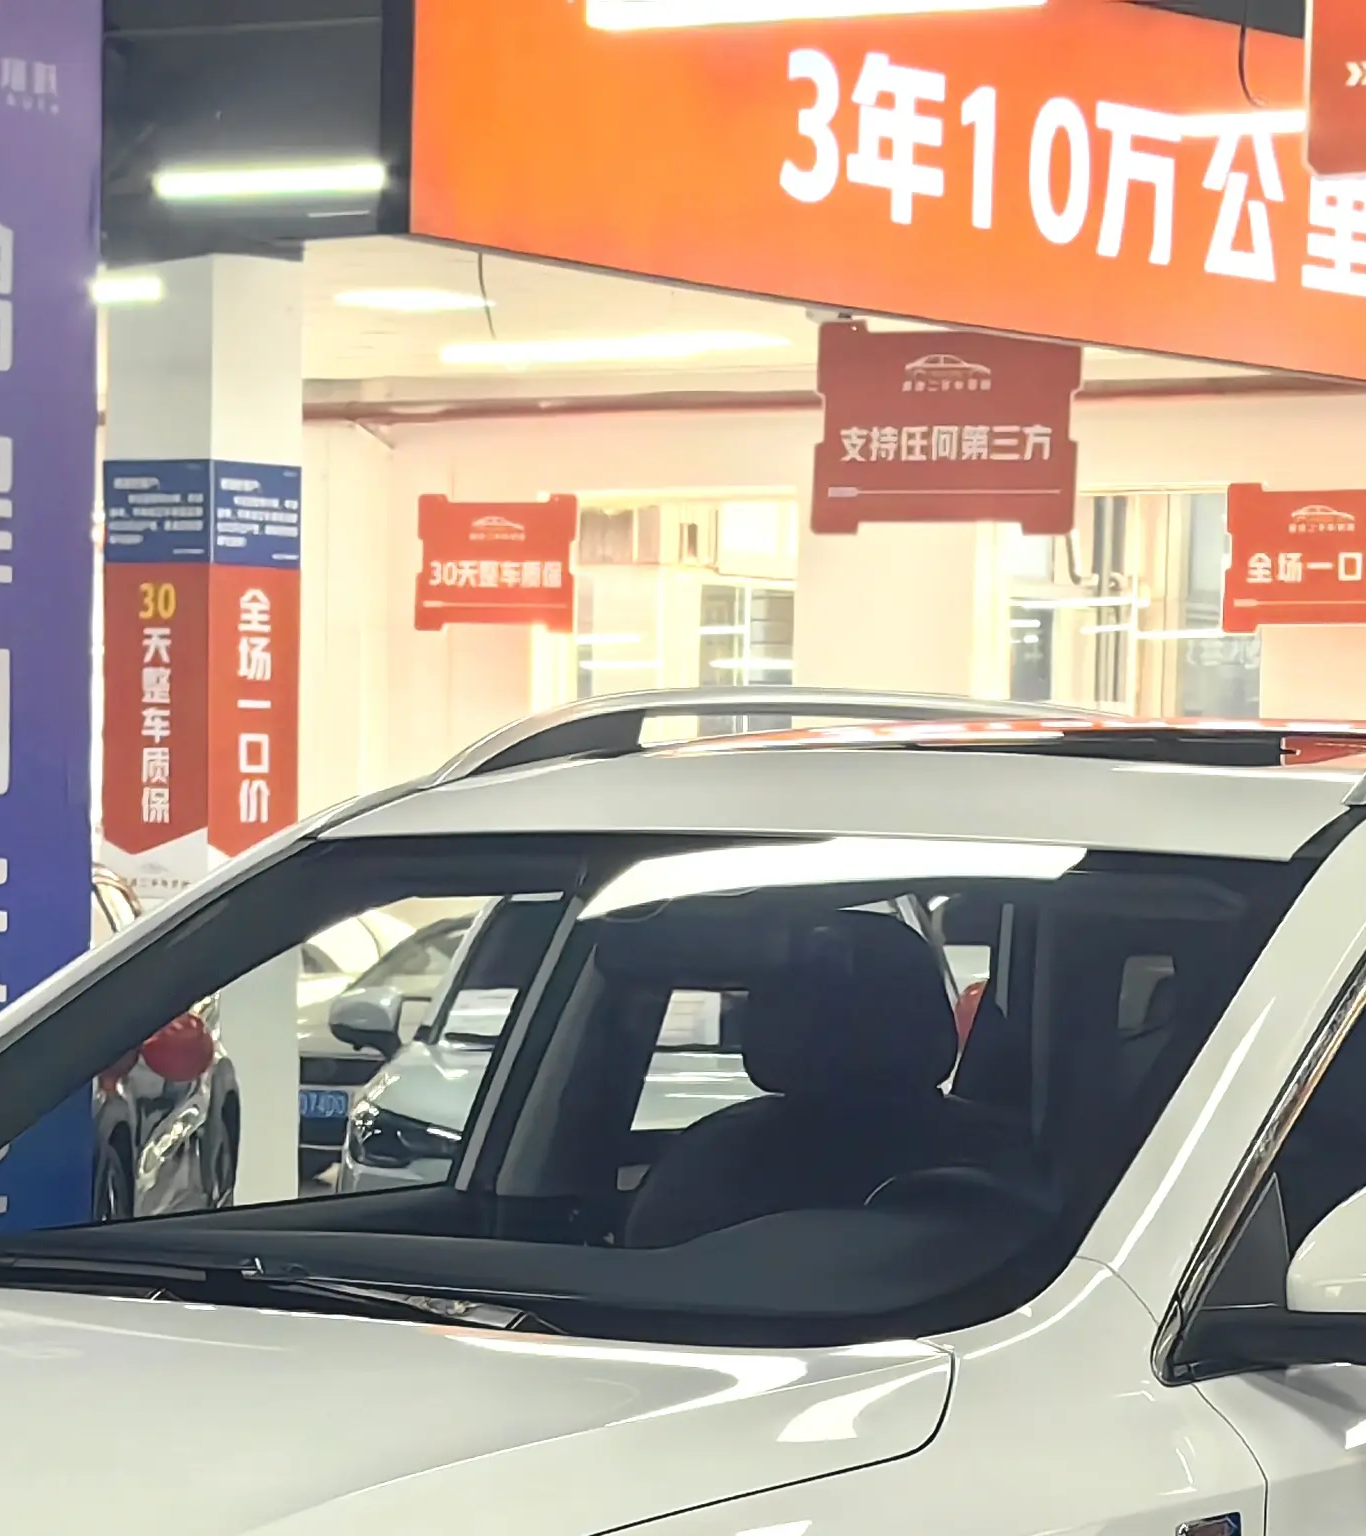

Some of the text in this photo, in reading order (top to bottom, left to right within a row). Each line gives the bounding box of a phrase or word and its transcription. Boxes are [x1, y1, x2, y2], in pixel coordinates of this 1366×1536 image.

[839, 423, 1053, 462] 支持任何第三方
[237, 588, 272, 823] 全场一口价
